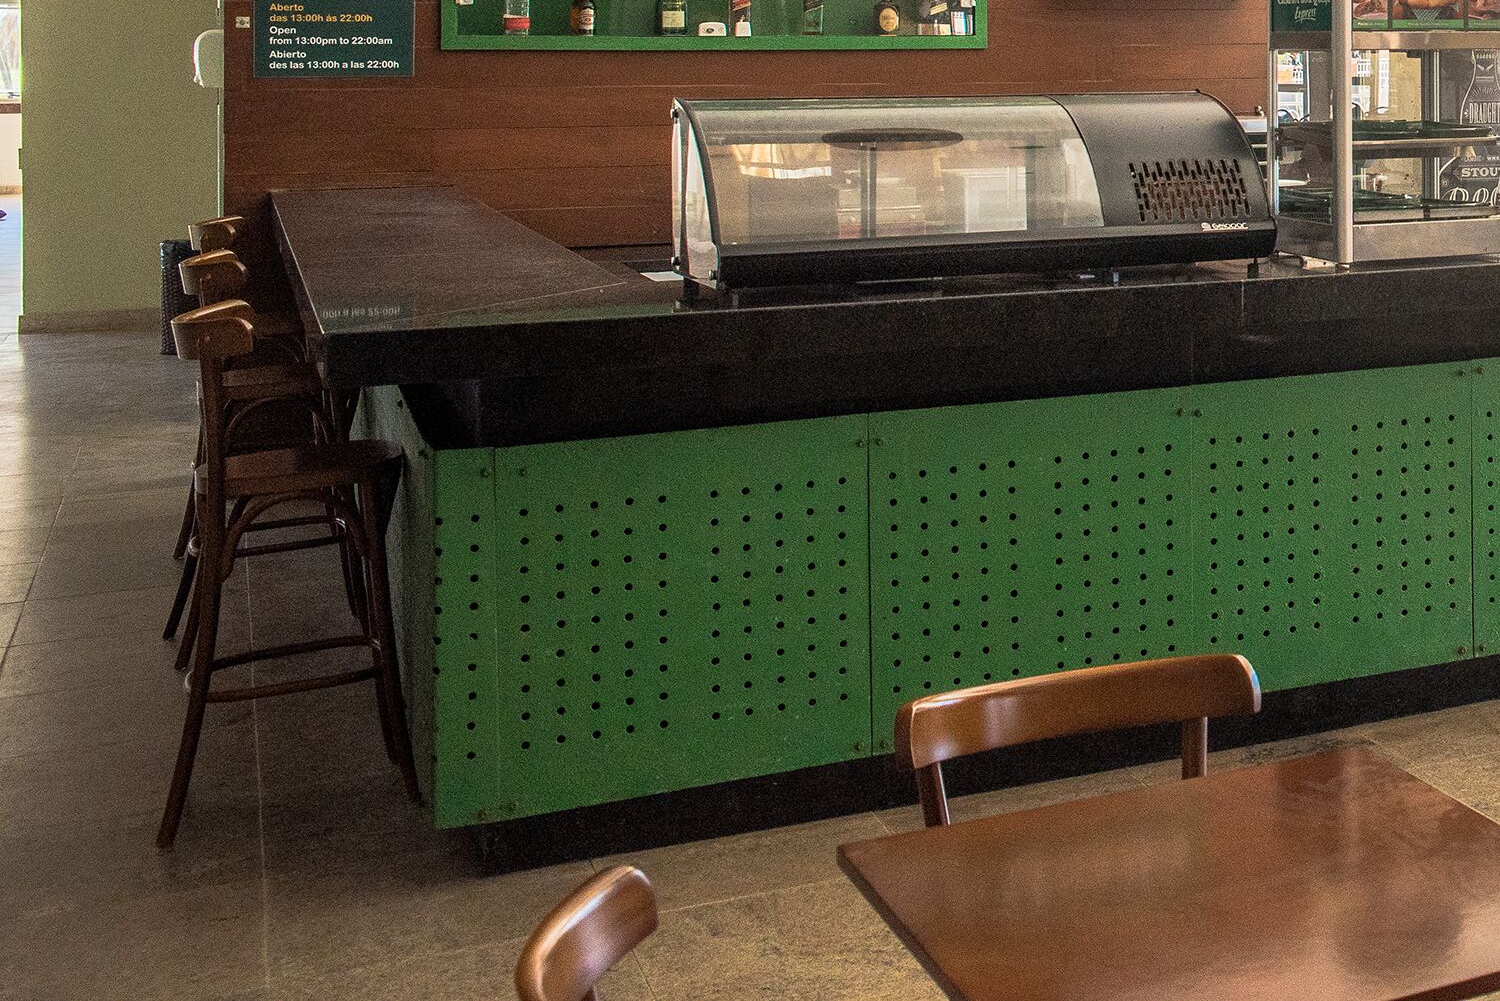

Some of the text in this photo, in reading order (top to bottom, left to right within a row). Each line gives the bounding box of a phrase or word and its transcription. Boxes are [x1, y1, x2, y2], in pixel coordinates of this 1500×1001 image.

[269, 3, 304, 12] Aberto
[269, 14, 288, 22] das
[290, 14, 324, 22] 13:00h
[339, 14, 373, 23] 22:00h
[269, 25, 297, 35] Open
[269, 36, 393, 46] from 13:00pm to 22:00am
[269, 50, 307, 59] Abierto
[269, 61, 288, 69] des
[290, 61, 305, 69] las
[307, 60, 340, 69] 13:00h
[350, 60, 365, 69] las
[366, 60, 400, 69] 22:00h
[1469, 102, 1500, 124] DRAUGHT
